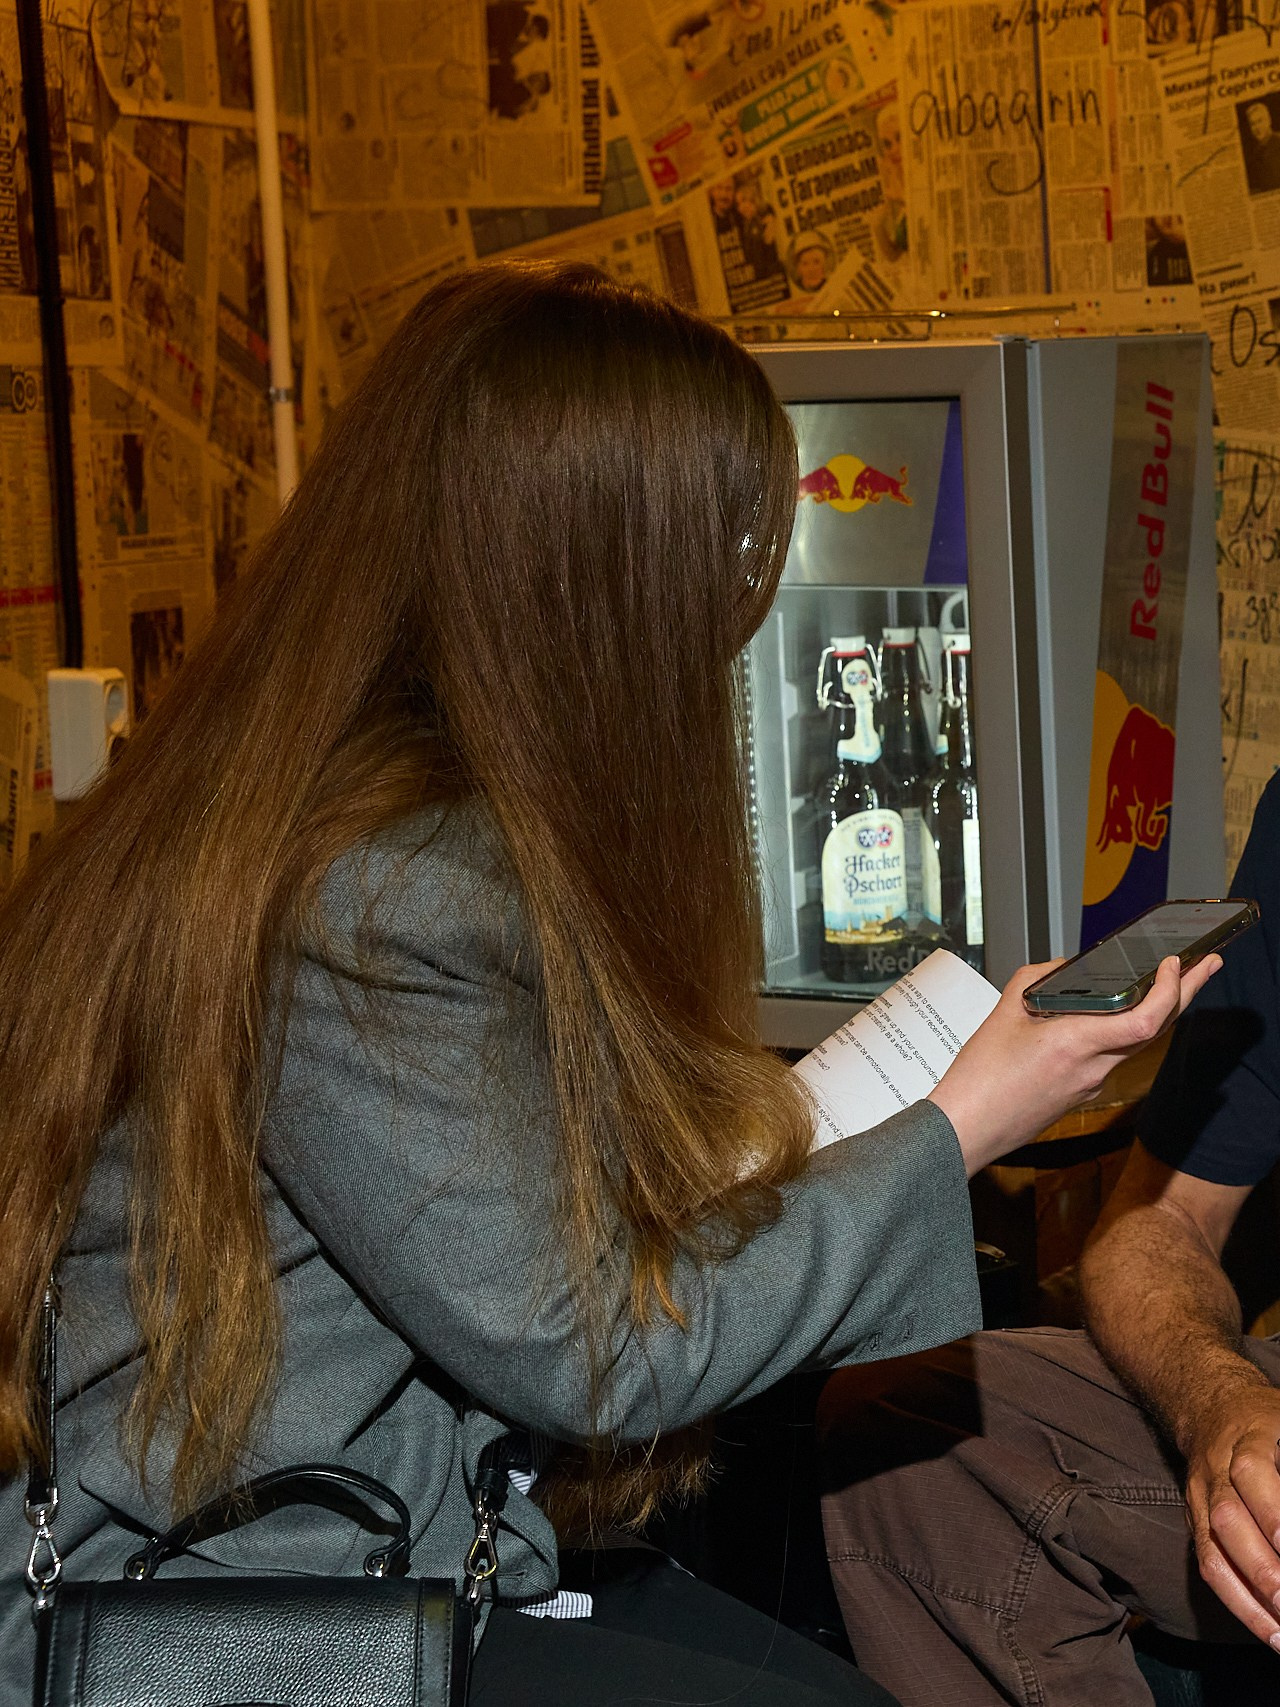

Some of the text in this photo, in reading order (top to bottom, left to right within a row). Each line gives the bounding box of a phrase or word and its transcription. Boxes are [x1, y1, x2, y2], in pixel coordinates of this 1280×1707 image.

[1129, 380, 1175, 642] Red Bull
[915, 1007, 929, 1022] your
[925, 1018, 943, 1038] recent
[926, 1004, 945, 1026] express
[889, 1021, 897, 1029] up
[894, 1026, 906, 1039] and
[901, 1038, 915, 1052] your
[894, 1041, 912, 1062] whole?
[860, 1047, 868, 1056] be
[864, 1053, 892, 1086] emotionally
[817, 1108, 831, 1122] style
[828, 1120, 841, 1134] and
